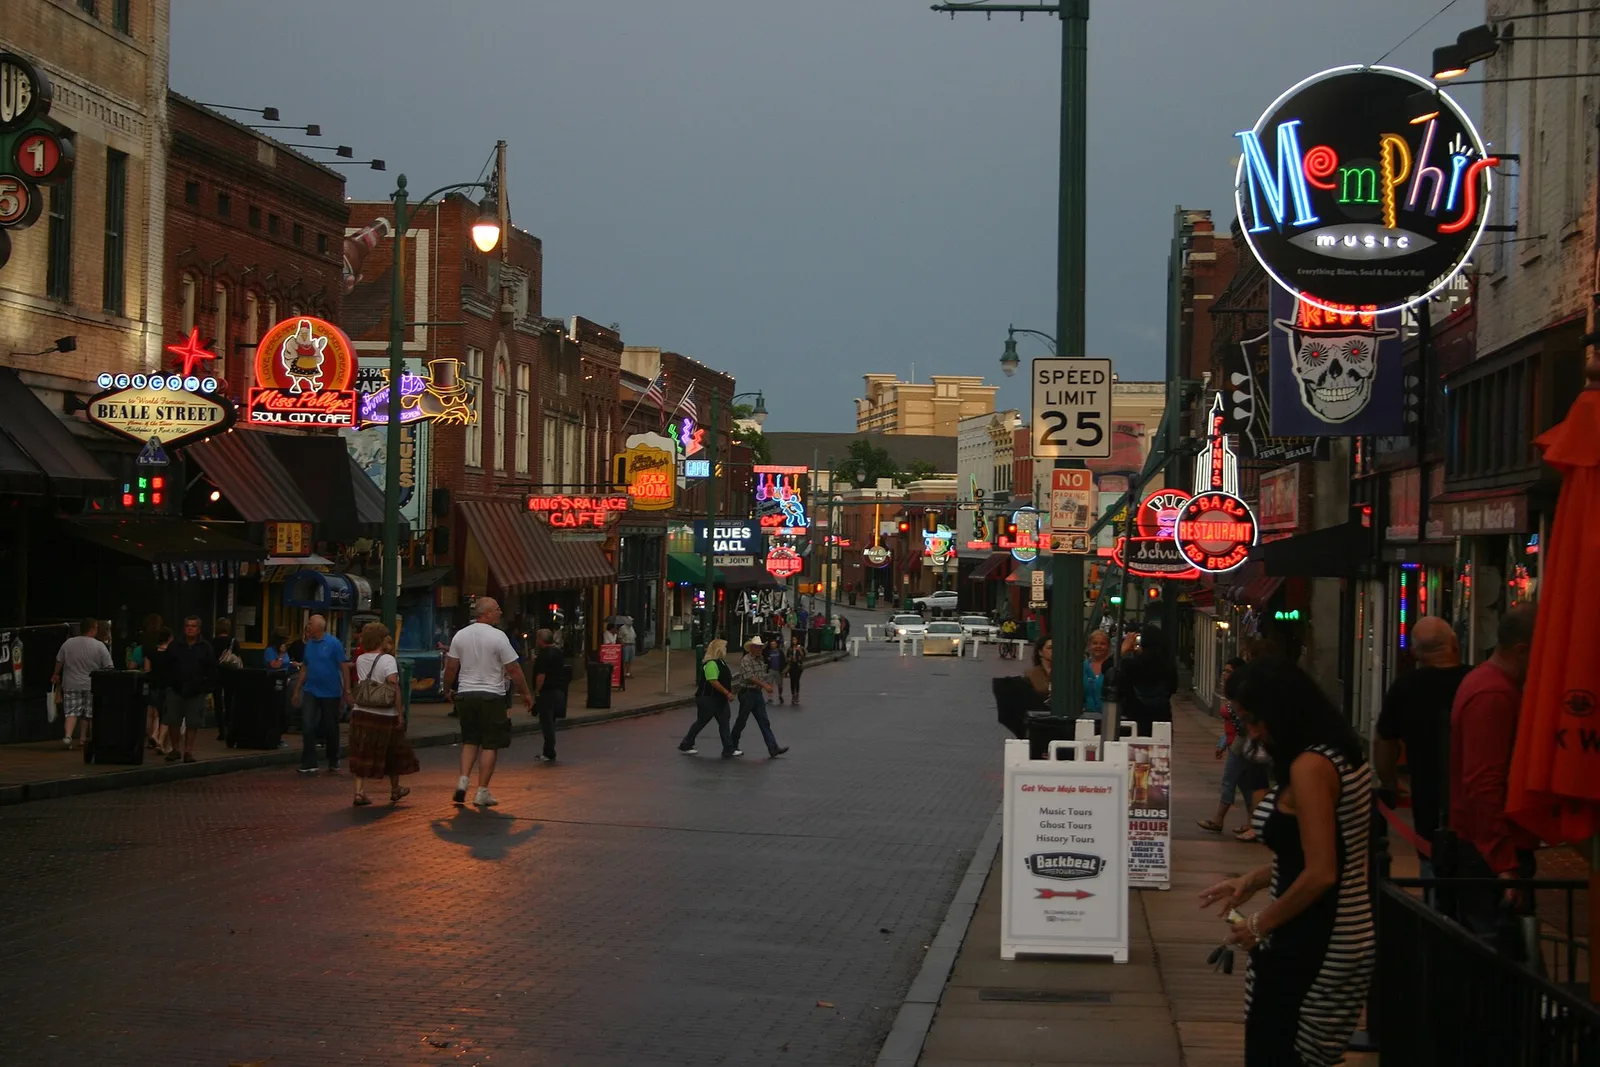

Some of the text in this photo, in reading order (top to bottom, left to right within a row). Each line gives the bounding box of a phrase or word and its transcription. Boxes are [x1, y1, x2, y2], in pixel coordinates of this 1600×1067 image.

[27, 140, 44, 172] 1
[1236, 111, 1499, 233] Memphis
[1316, 235, 1408, 248] music
[1296, 268, 1335, 276] Everything
[1336, 268, 1359, 277] Blues,
[1360, 268, 1376, 276] Soul
[98, 374, 217, 391] WELCOME
[1038, 370, 1105, 384] SPEED
[135, 396, 158, 404] World
[252, 389, 297, 407] Miss
[1046, 391, 1097, 405] LIMIT
[97, 404, 218, 421] BEALE STREET
[252, 411, 351, 424] SOUL CITY CAFE
[1038, 410, 1103, 447] 25
[640, 474, 667, 484] TAP
[1060, 473, 1083, 487] NO
[528, 495, 628, 510] KING'S PALACE
[1198, 495, 1237, 513] BAR
[550, 511, 606, 527] CAFE
[1180, 521, 1253, 541] RESTAURANT
[728, 557, 750, 565] JOINT
[1185, 543, 1249, 569] 159 BEALE
[1021, 784, 1035, 792] Get
[1037, 784, 1056, 793] Your
[1057, 785, 1077, 794] Mojo
[1039, 807, 1093, 816] Music Tours
[1134, 808, 1168, 818] BUDS
[1039, 820, 1092, 830] Ghost Tours
[1128, 821, 1169, 831] HOUR
[1036, 834, 1095, 845] History Tours
[1036, 855, 1097, 870] Backbeat
